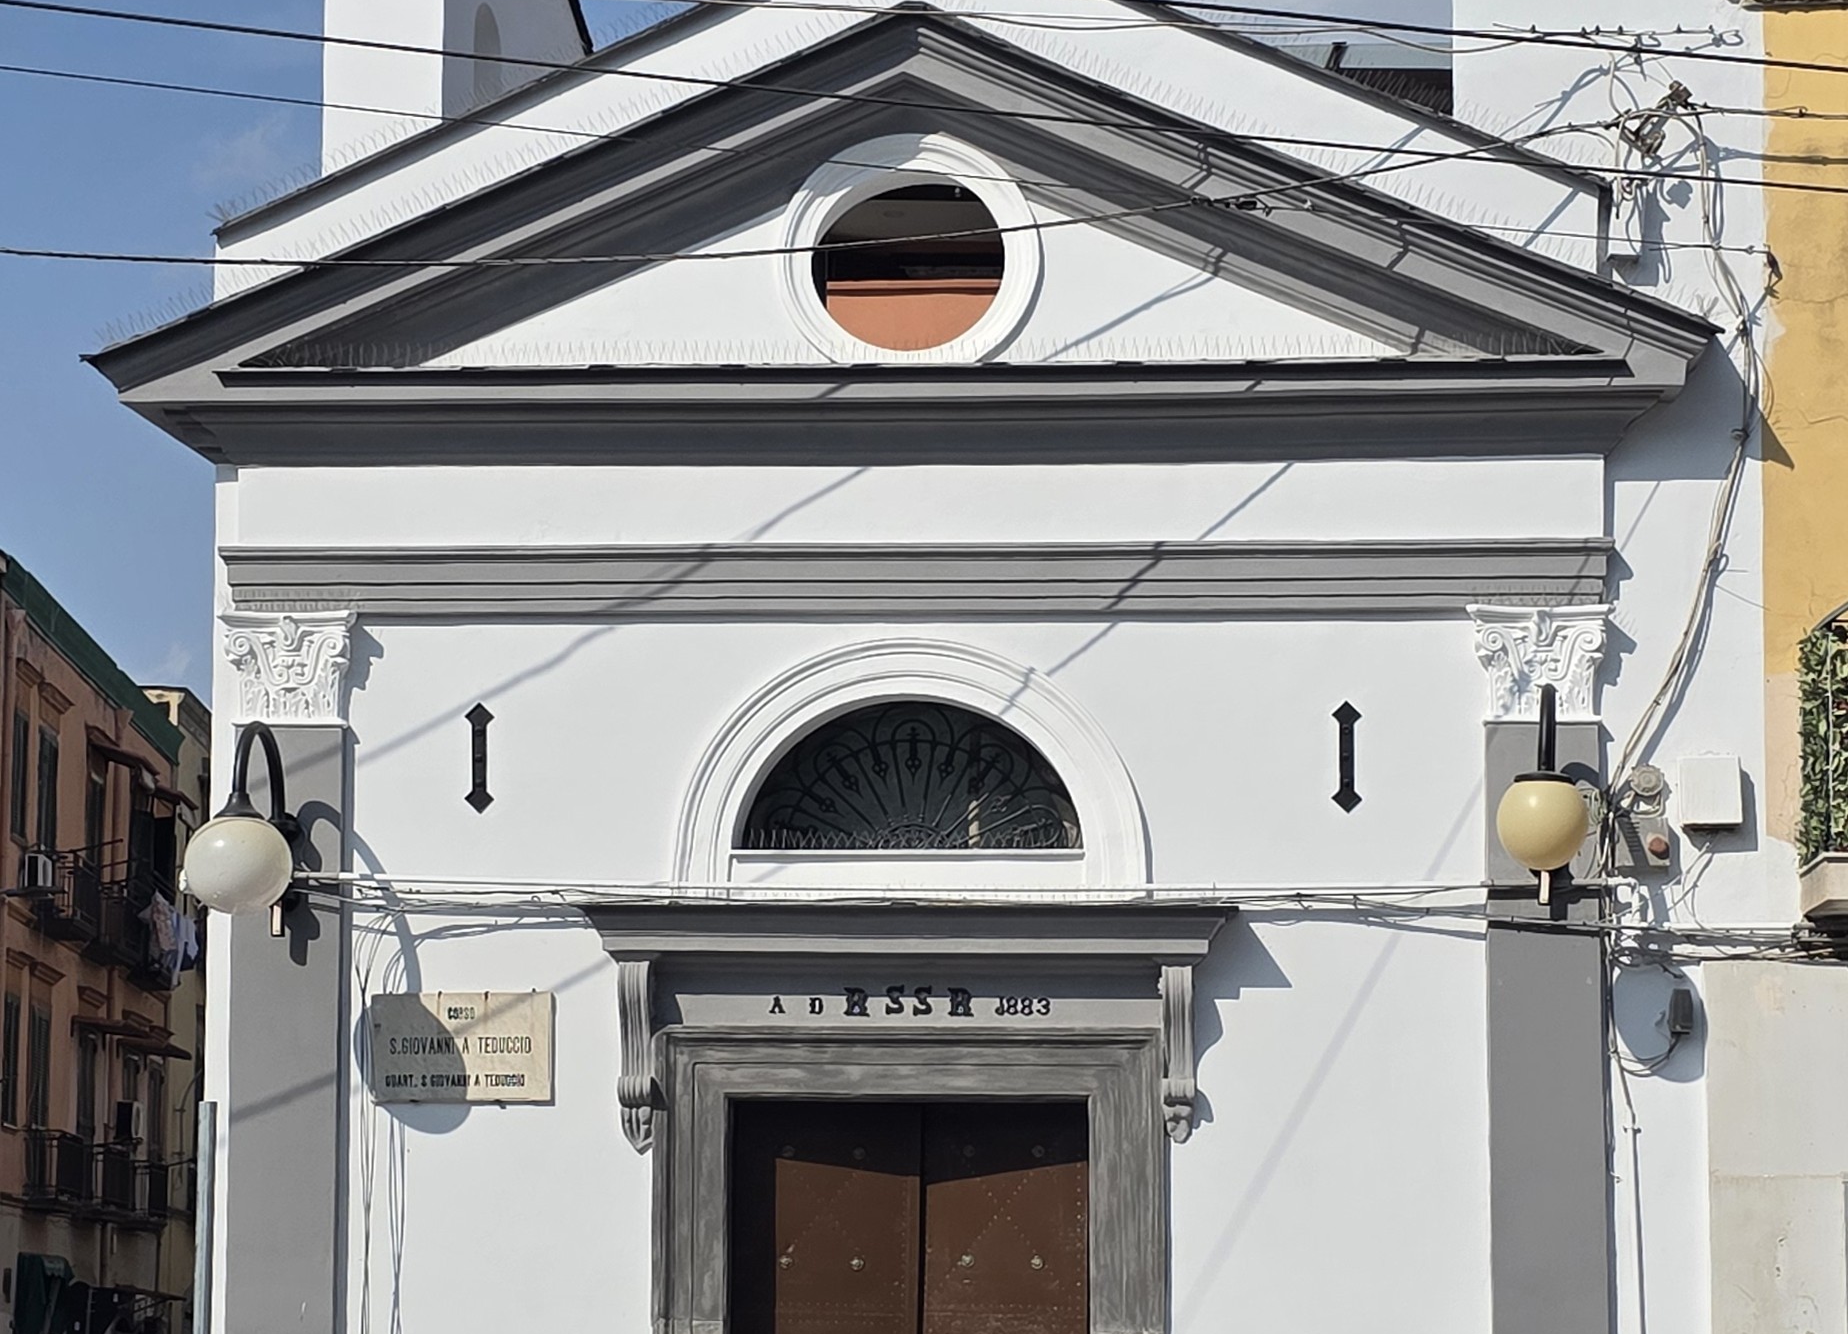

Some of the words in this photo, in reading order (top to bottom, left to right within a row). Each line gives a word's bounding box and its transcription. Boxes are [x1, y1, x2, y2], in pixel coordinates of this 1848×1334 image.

[447, 1006, 476, 1020] CORSO
[768, 996, 786, 1015] A
[808, 997, 824, 1015] D
[462, 1036, 470, 1055] A
[478, 1036, 533, 1055] TEDUCCIO
[430, 1073, 471, 1088] GIOVANNI
[474, 1073, 481, 1087] A
[484, 1073, 526, 1087] TEDUCCIO
